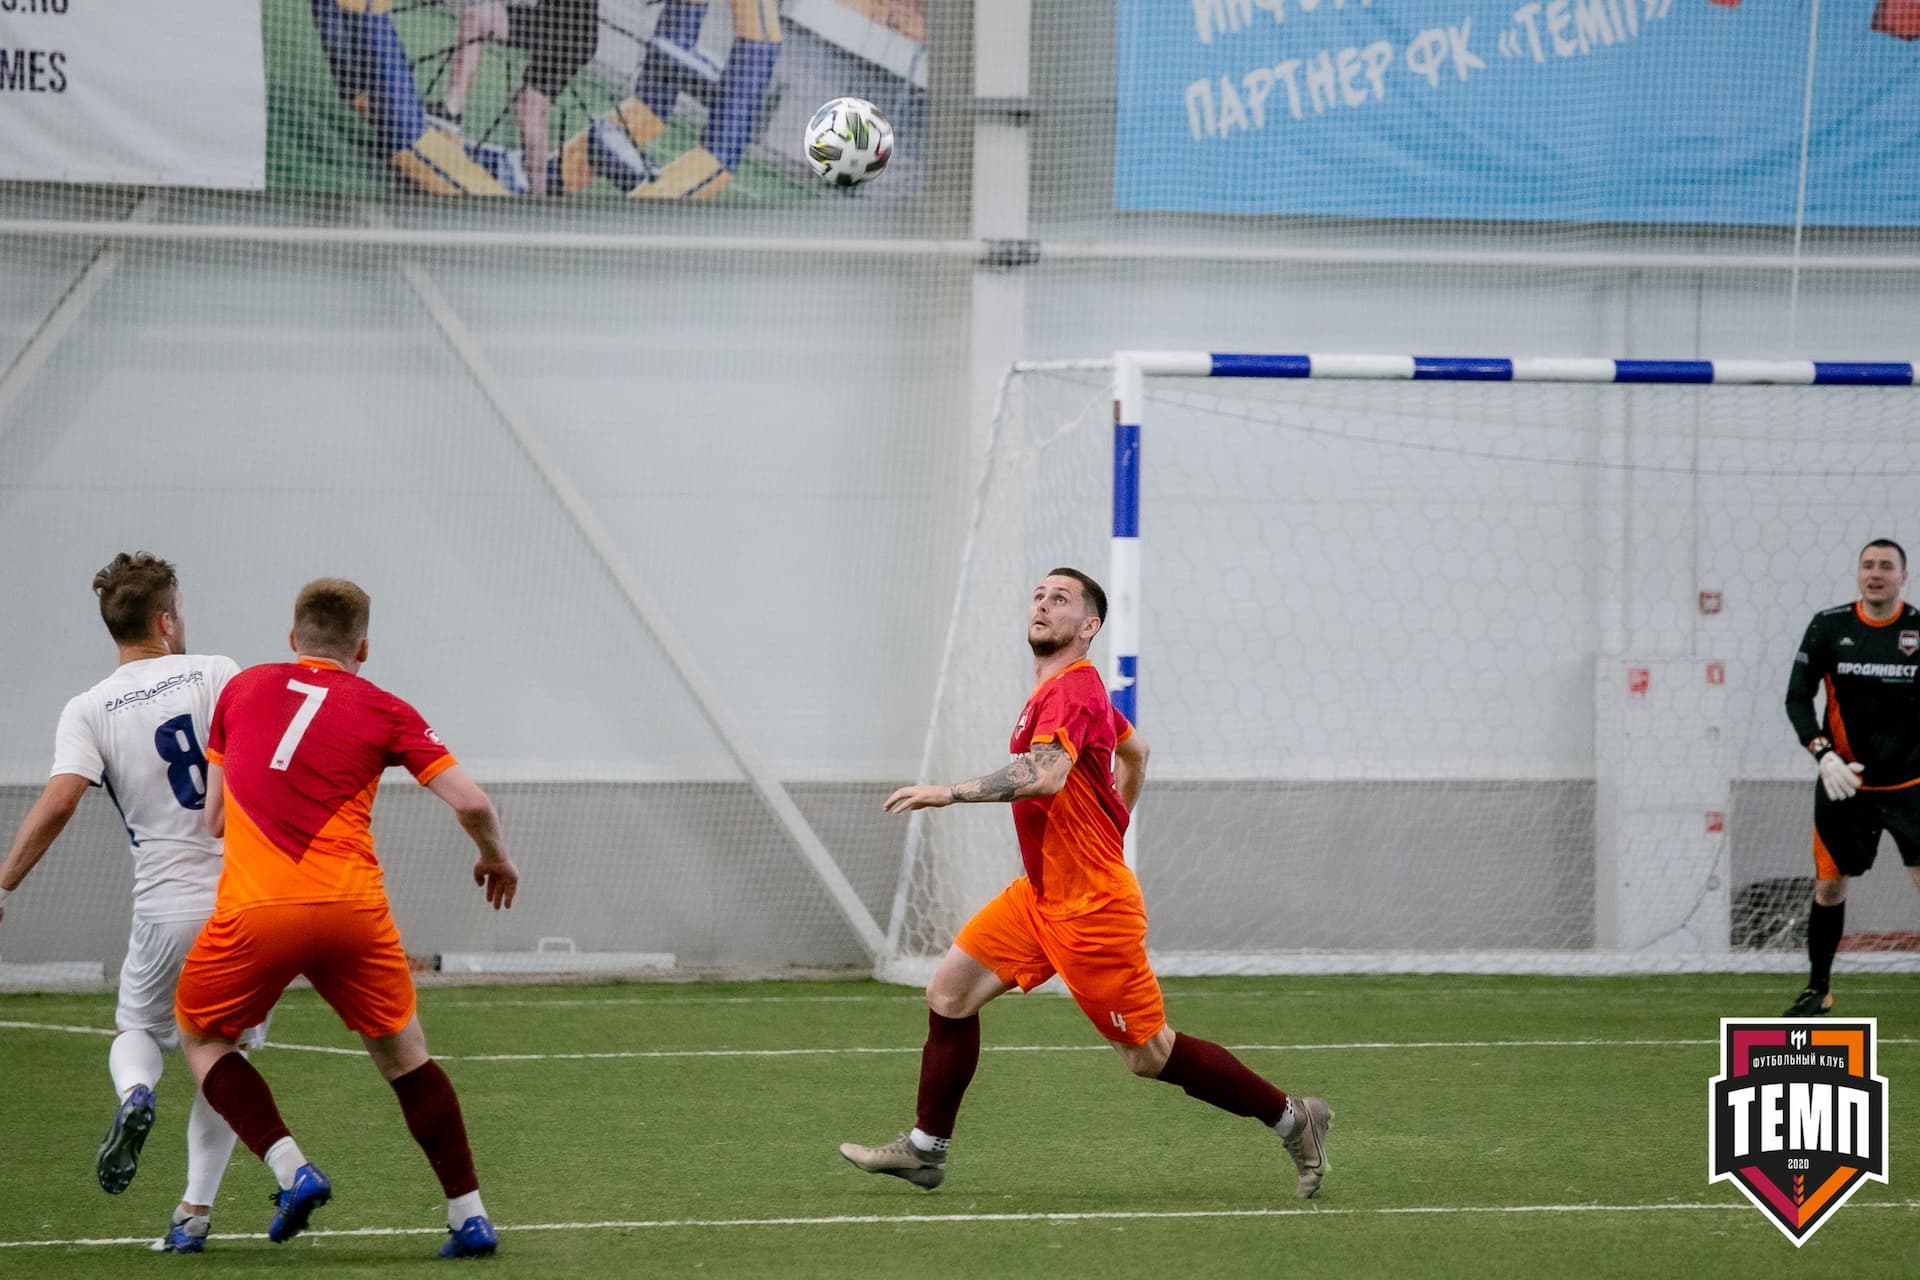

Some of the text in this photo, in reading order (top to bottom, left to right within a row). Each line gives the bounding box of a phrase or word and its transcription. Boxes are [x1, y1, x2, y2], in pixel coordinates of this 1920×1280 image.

[0, 49, 67, 94] MES
[1184, 39, 1394, 141] ПАРТНЕР
[1405, 14, 1487, 90] ФК
[1837, 662, 1918, 678] ПРОДИНВЕСТ
[269, 678, 330, 772] 7
[154, 713, 209, 811] 8
[1109, 1010, 1127, 1032] 4
